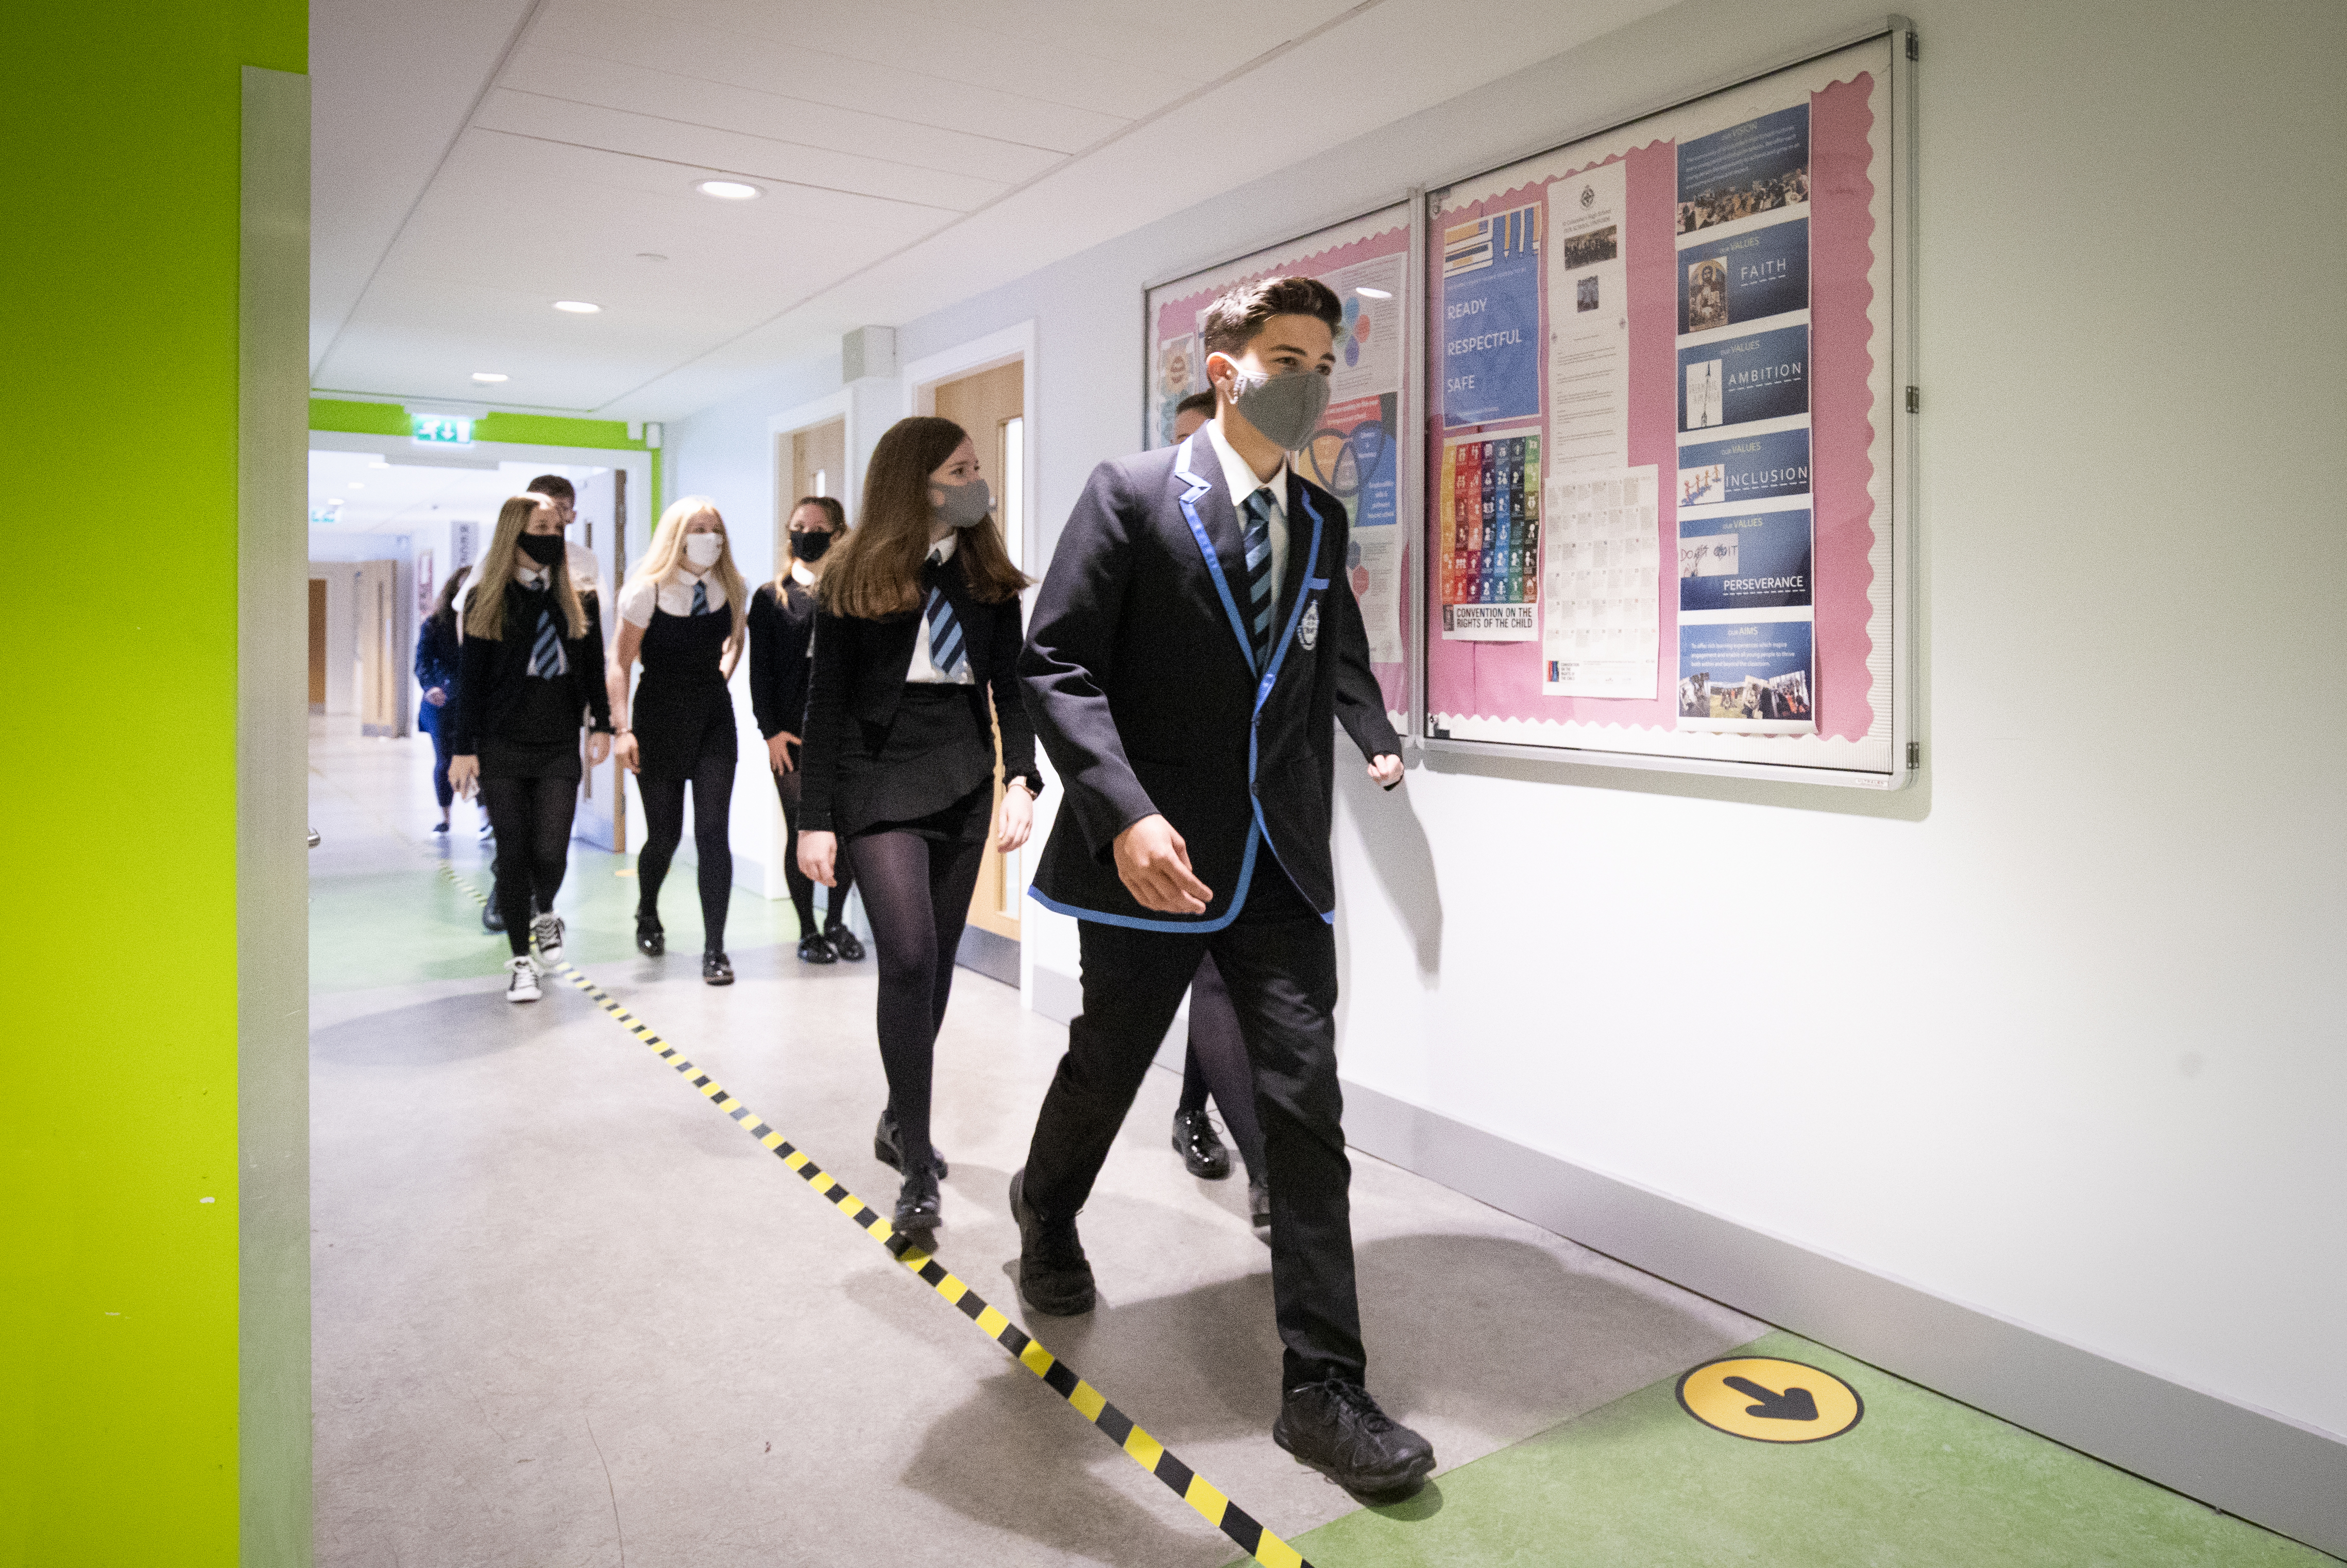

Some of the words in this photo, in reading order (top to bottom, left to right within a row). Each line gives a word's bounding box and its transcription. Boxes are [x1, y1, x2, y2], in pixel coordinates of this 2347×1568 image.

[1741, 258, 1787, 280] FAITH
[1447, 298, 1487, 320] READY
[1448, 329, 1522, 356] RESPECTFUL
[1731, 340, 1760, 353] VALUES
[1728, 362, 1801, 385] AMBITION
[1447, 374, 1475, 393] SAFE
[1732, 441, 1761, 453] VALUES
[1726, 466, 1808, 487] INCLUSION
[1733, 518, 1763, 529] VALUES
[1724, 575, 1803, 591] PERSEVERANCE
[1457, 607, 1503, 619] CONVENTION
[1506, 607, 1516, 618] ON
[1518, 606, 1532, 617] THE
[1457, 619, 1481, 628] RIGHTS
[1484, 619, 1493, 628] OF
[1495, 618, 1509, 628] THE
[1511, 618, 1533, 628] CHILD
[1739, 626, 1758, 635] AIMS
